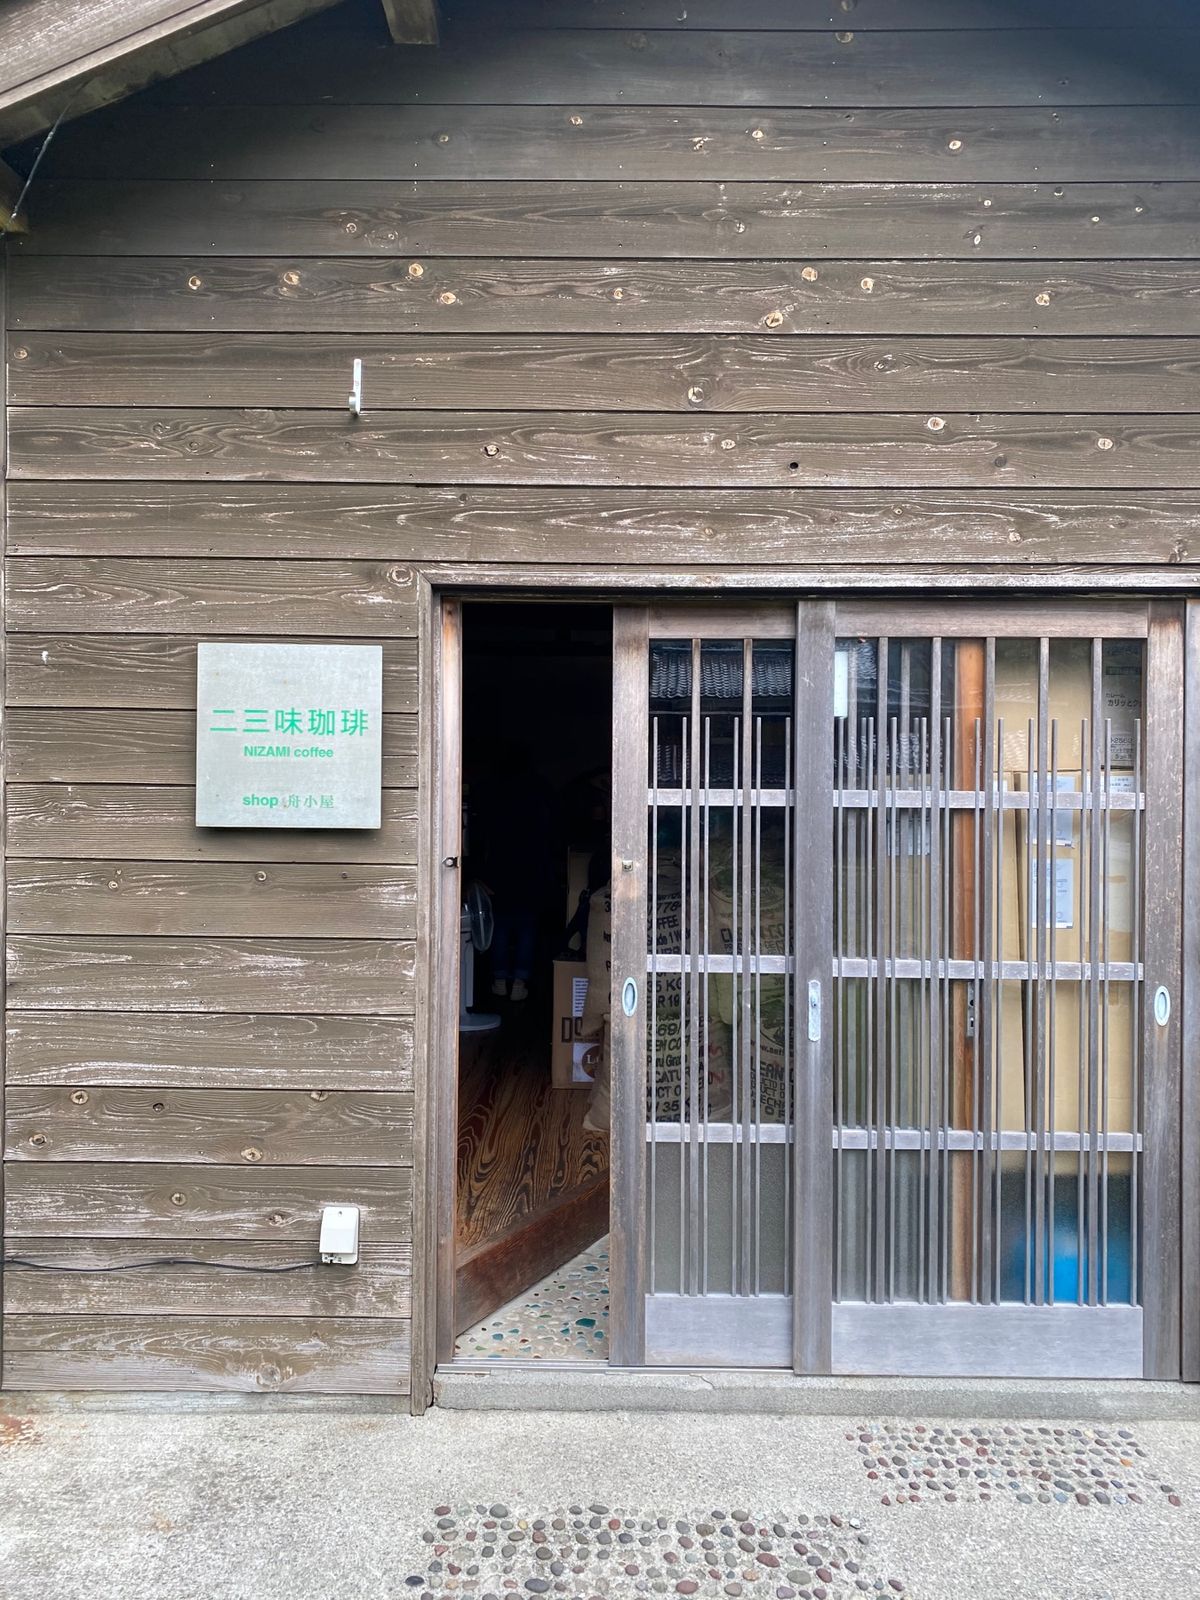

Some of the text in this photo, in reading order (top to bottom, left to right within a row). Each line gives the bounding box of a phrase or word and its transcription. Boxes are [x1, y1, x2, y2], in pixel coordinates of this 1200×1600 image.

[210, 708, 369, 736] 二三味珈琲
[243, 745, 334, 758] NIZAMI coffee
[242, 793, 334, 809] shop 舟小屋
[647, 914, 680, 931] FFEE
